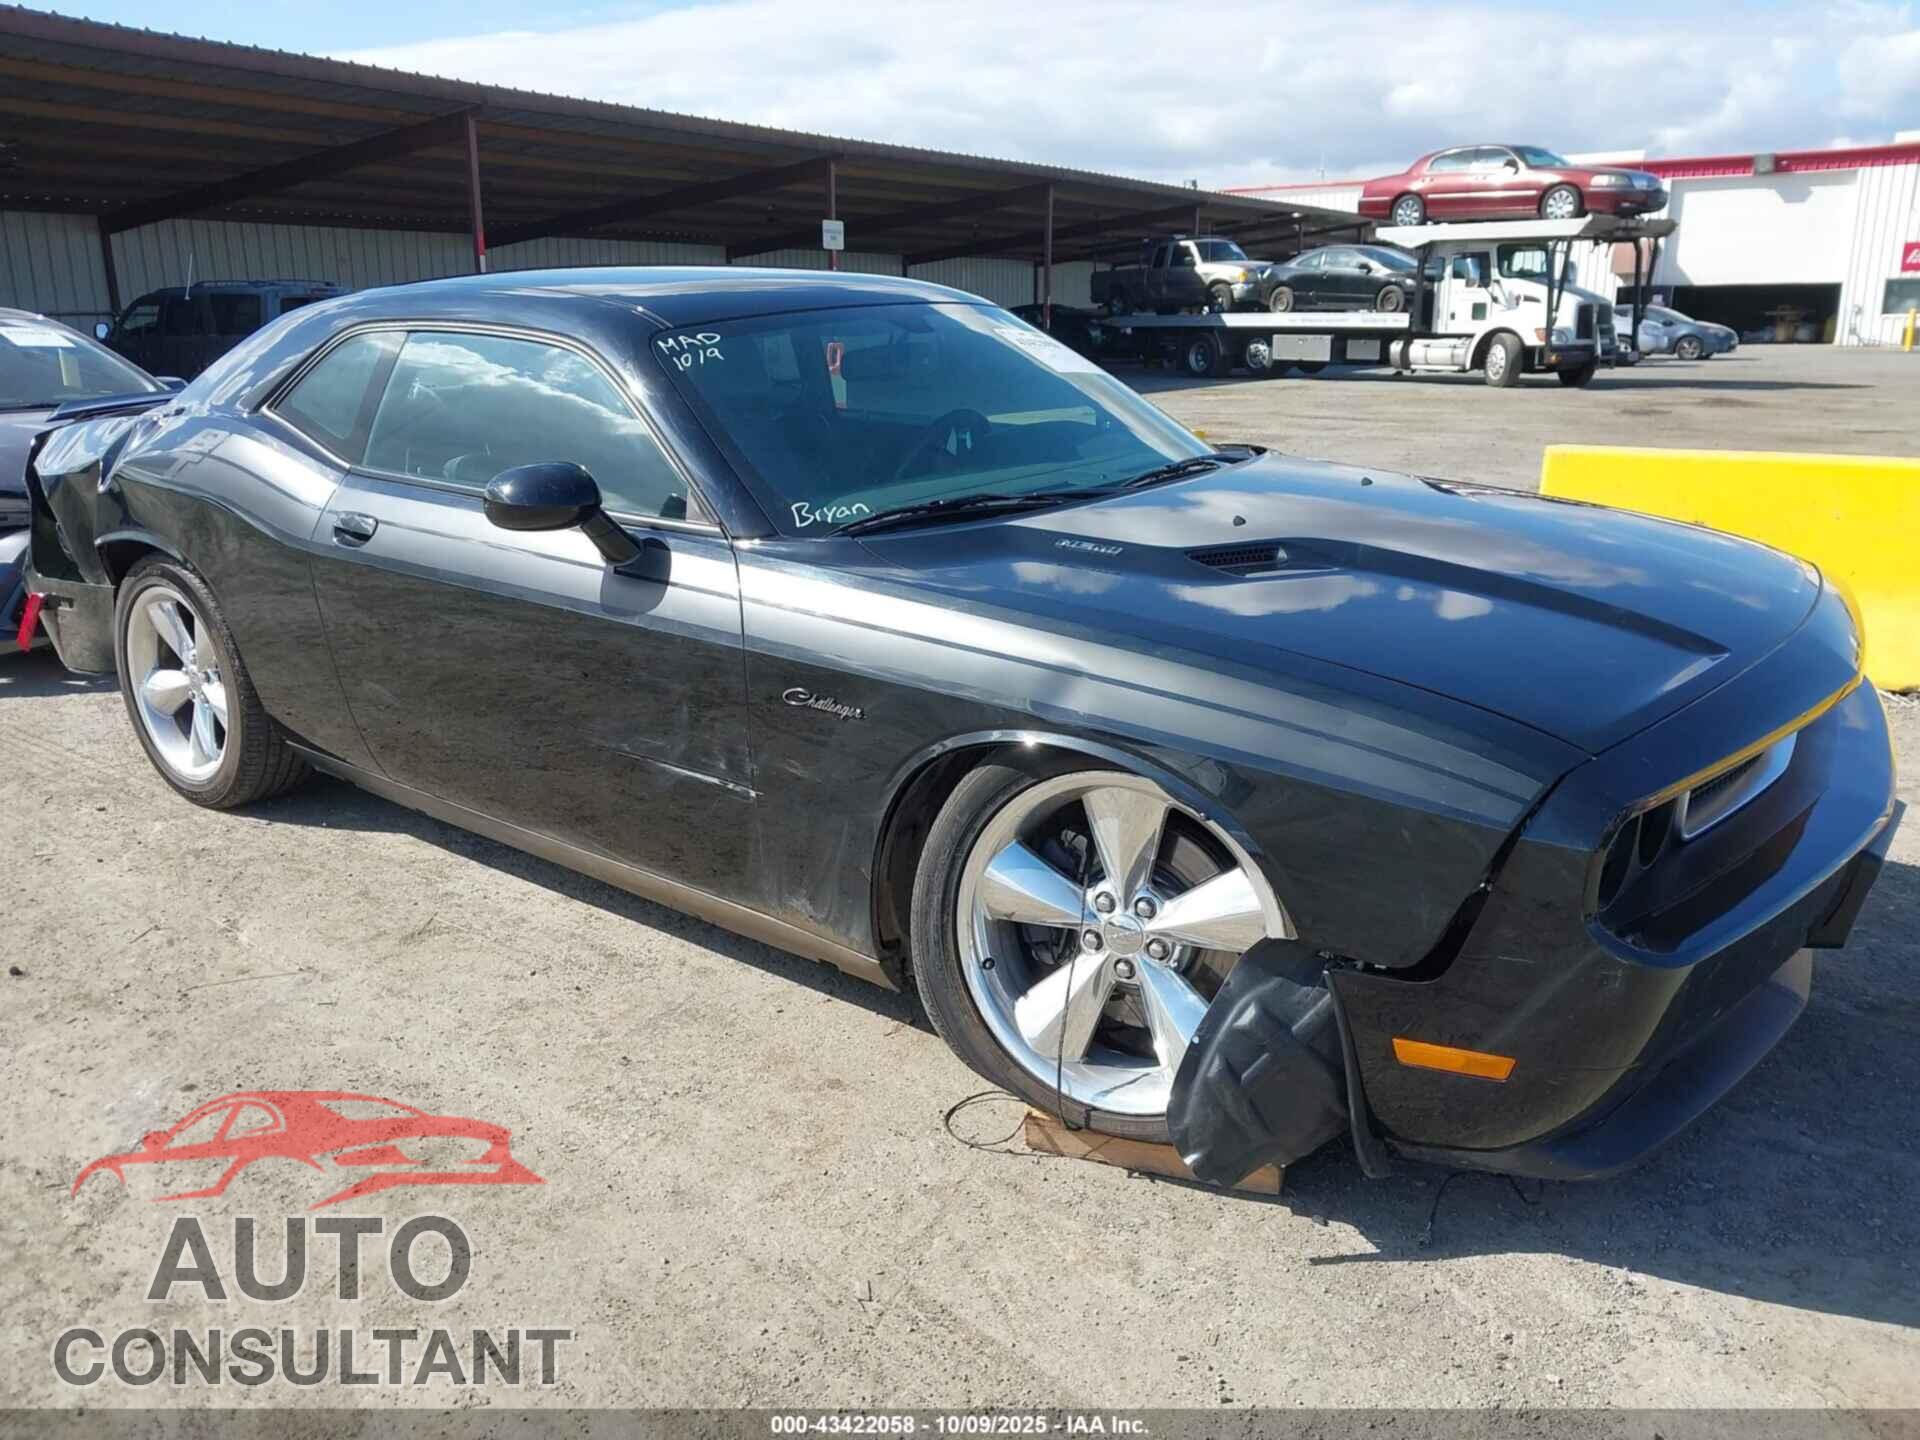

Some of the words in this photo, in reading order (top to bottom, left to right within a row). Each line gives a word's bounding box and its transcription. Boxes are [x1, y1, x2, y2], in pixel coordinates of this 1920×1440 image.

[656, 332, 721, 355] MAD
[790, 501, 871, 528] Bryan
[782, 687, 864, 721] Challenger
